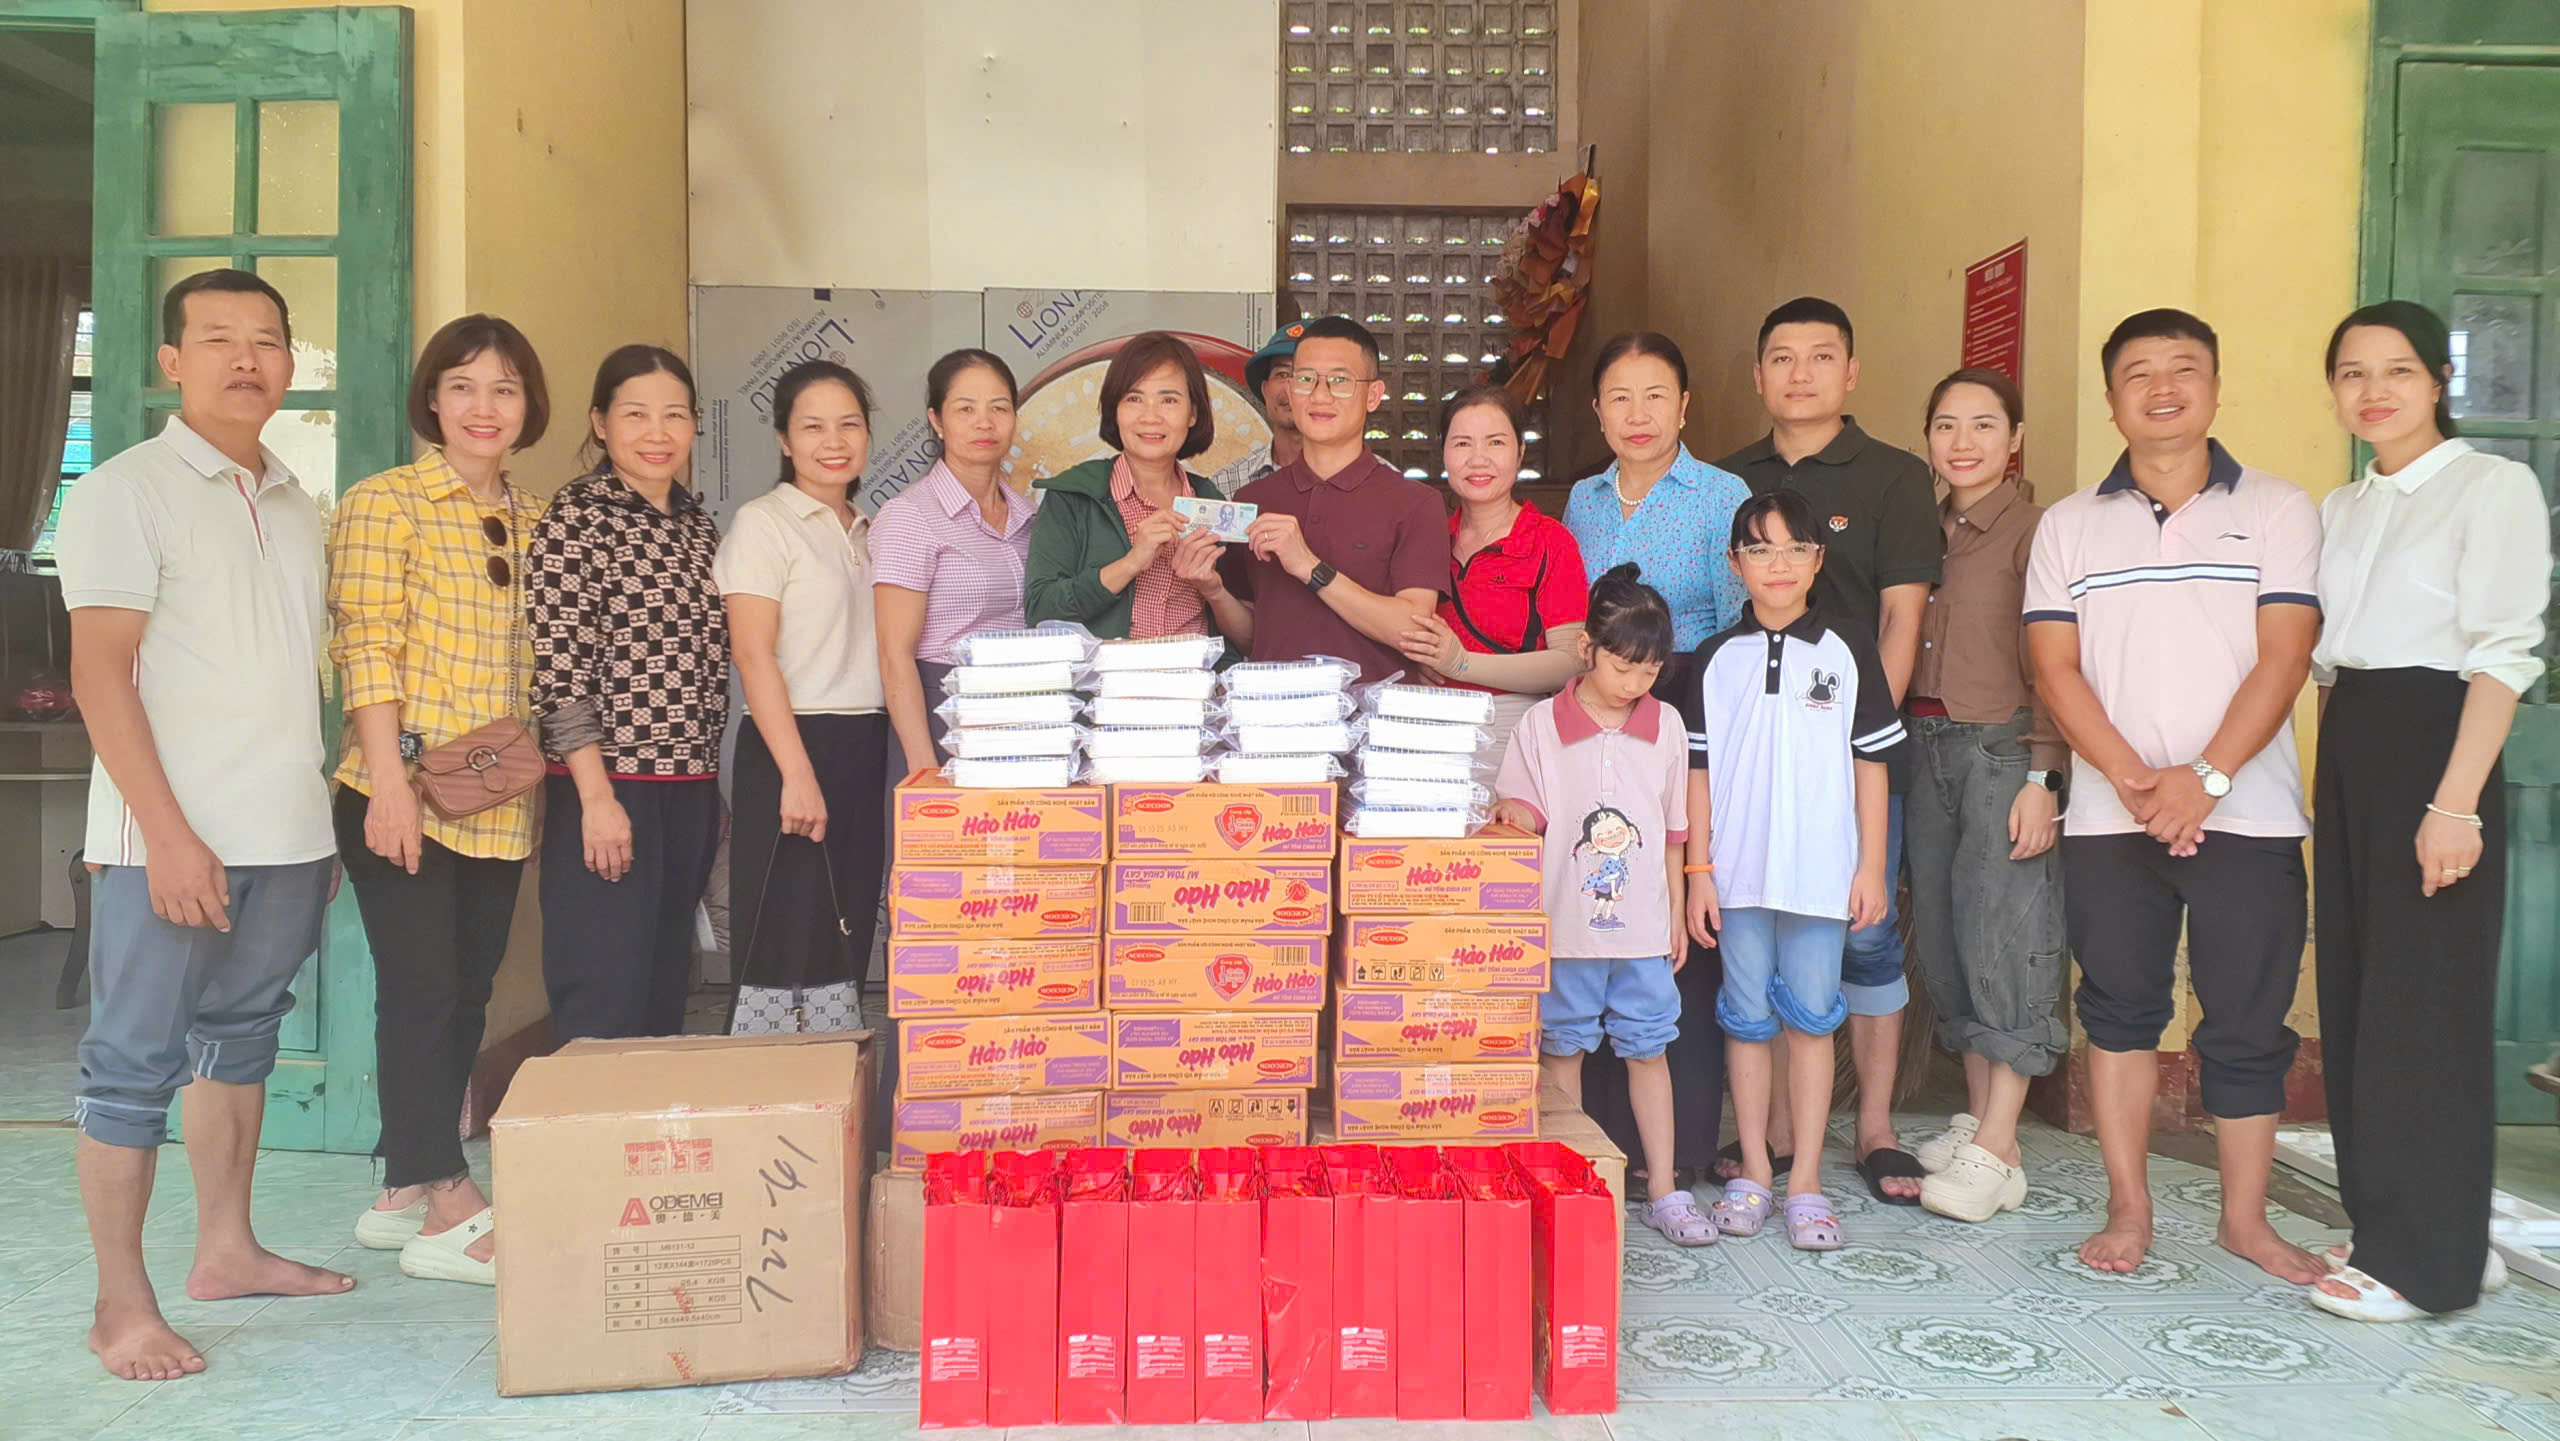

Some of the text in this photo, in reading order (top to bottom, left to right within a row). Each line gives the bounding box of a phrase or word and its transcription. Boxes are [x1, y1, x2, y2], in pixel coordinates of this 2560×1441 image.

[786, 317, 801, 332] ISO
[1059, 300, 1110, 350] ISO 9001 2008
[1035, 325, 1070, 359] ALUMINIUM
[756, 341, 793, 378] COMPOSITE
[906, 416, 920, 431] ISO
[877, 439, 913, 476] COMPOSITE
[867, 436, 942, 509] ONALU
[962, 808, 1040, 835] Hảo Hảo
[1262, 818, 1326, 842] Hảo Hảo
[1125, 871, 1198, 879] MÌ TÔM CHUA CAY
[1406, 858, 1481, 886] Hảo Hảo
[960, 894, 1039, 921] Hảo Hảo
[1174, 878, 1270, 914] Hảo Hảo
[1451, 940, 1524, 967] Hảo Hảo
[957, 967, 1035, 997] Hảo Hảo
[1253, 970, 1316, 993] Hảo Hảo
[1401, 1018, 1477, 1044] Hảo Hảo
[968, 1034, 1047, 1066] Hảo Hảo
[1179, 1042, 1254, 1072] Hảo Hảo
[1400, 1094, 1476, 1122] Hảo Hảo
[1000, 1123, 1038, 1146] Hảo
[1128, 1113, 1202, 1142] Hảo Hảo
[650, 1192, 722, 1210] ODEMEI
